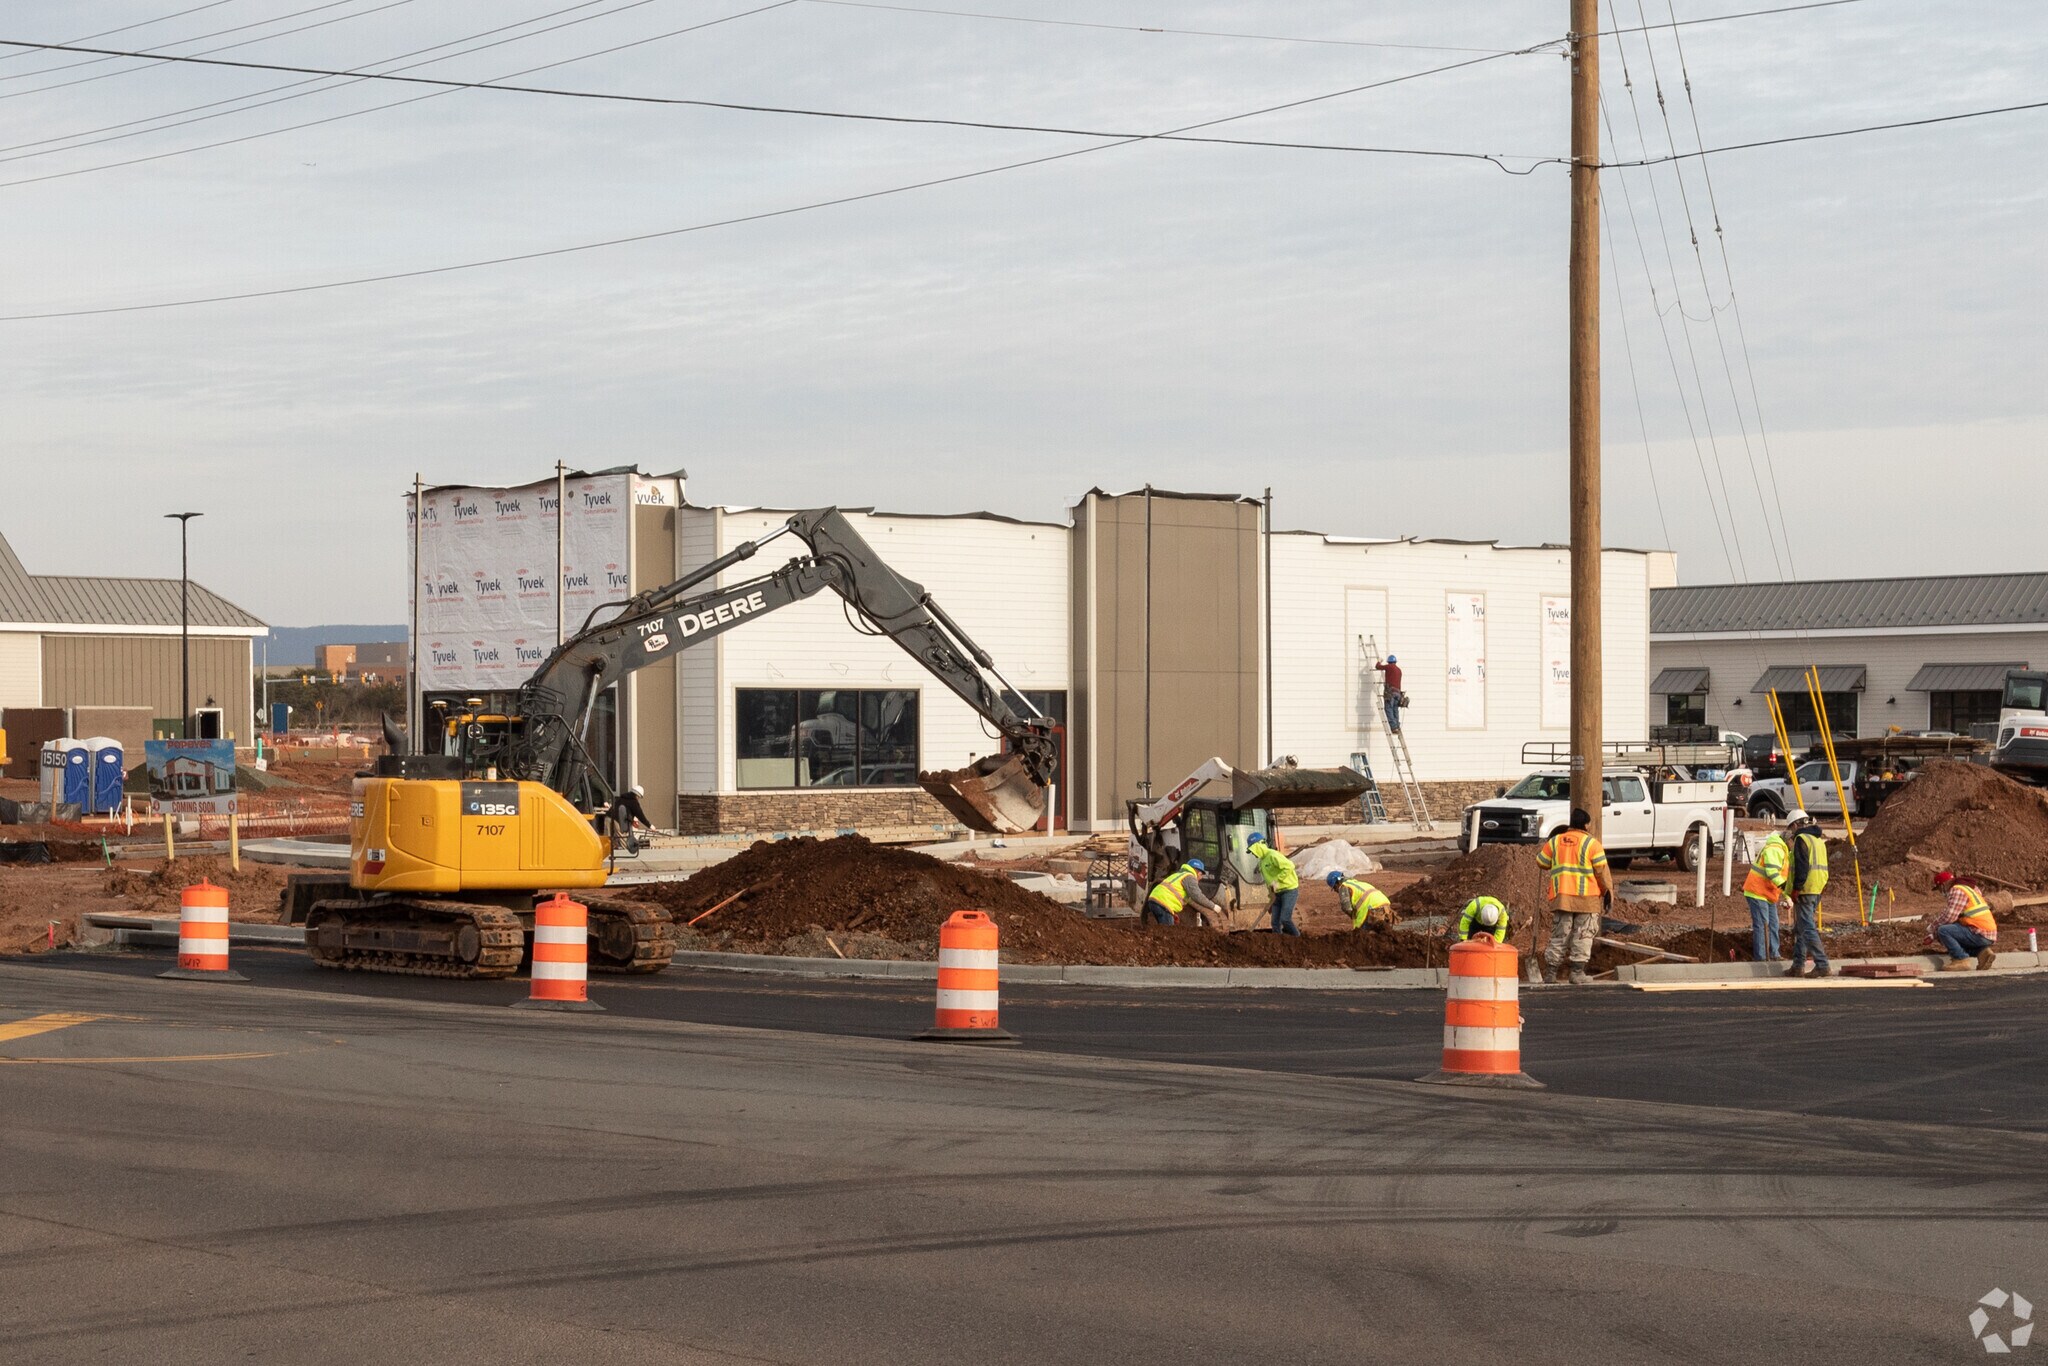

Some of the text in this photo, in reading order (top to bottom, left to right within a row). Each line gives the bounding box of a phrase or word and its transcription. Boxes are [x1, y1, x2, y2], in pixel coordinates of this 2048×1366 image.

[539, 497, 559, 512] Tyve
[583, 491, 612, 508] Tyvek
[635, 491, 665, 504] yvek
[453, 503, 479, 519] Tyvek
[495, 499, 521, 516] Tyvek
[475, 579, 501, 594] Tyvek
[518, 575, 545, 592] Tyvek
[607, 572, 628, 588] Tyve
[678, 591, 766, 637] DEERE
[1472, 604, 1485, 617] Tyv
[1547, 608, 1569, 621] Tyvek
[637, 618, 664, 636] 7107
[432, 650, 457, 665] Tyvek
[473, 648, 499, 663] Tyvek
[515, 647, 543, 662] Tyvek
[1552, 667, 1570, 680] Tyve
[43, 751, 67, 767] 15150
[172, 801, 216, 813] COMING SOON
[351, 802, 364, 817] ERE
[480, 803, 516, 815] 135G
[477, 825, 505, 836] 7107
